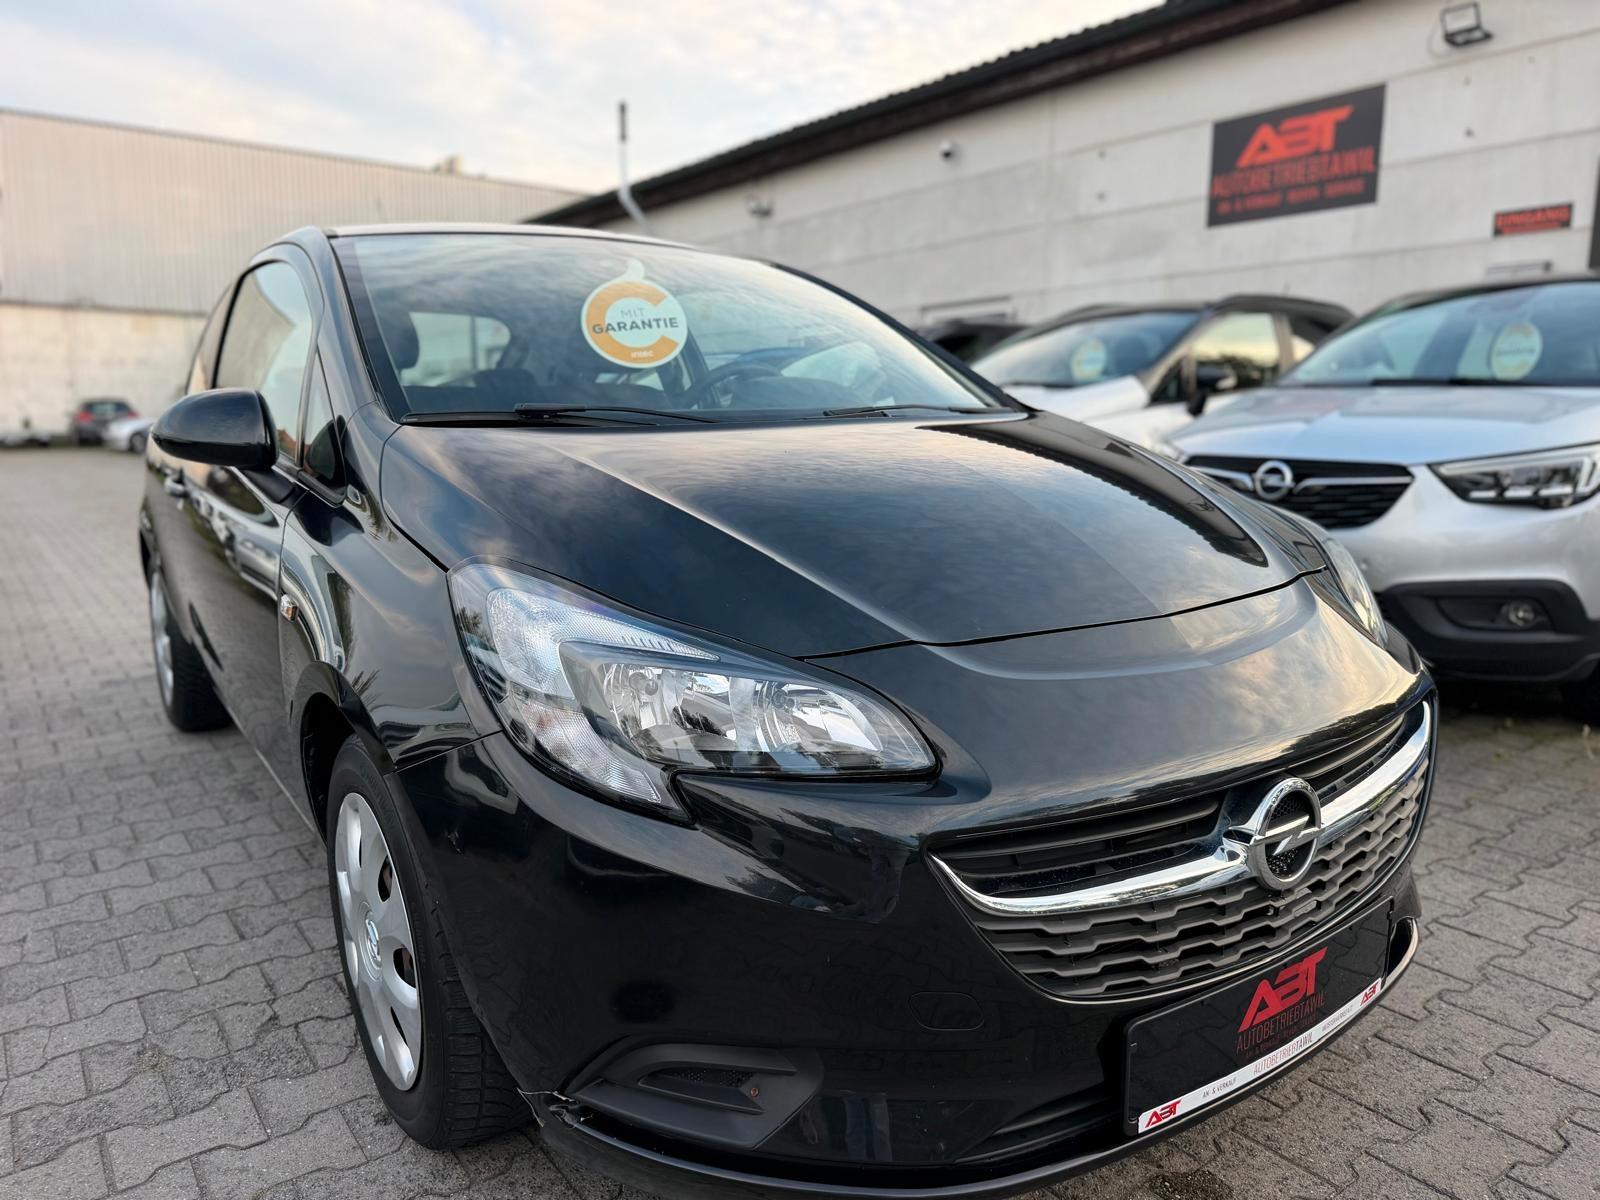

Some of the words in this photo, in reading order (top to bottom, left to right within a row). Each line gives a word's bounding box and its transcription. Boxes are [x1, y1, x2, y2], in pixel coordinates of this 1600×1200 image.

[1236, 104, 1355, 169] ABT
[592, 317, 679, 334] GARANTIE
[620, 308, 645, 319] MIT
[1238, 947, 1328, 1033] ABT
[1360, 981, 1379, 1006] ABT
[1145, 1099, 1183, 1128] ABT
